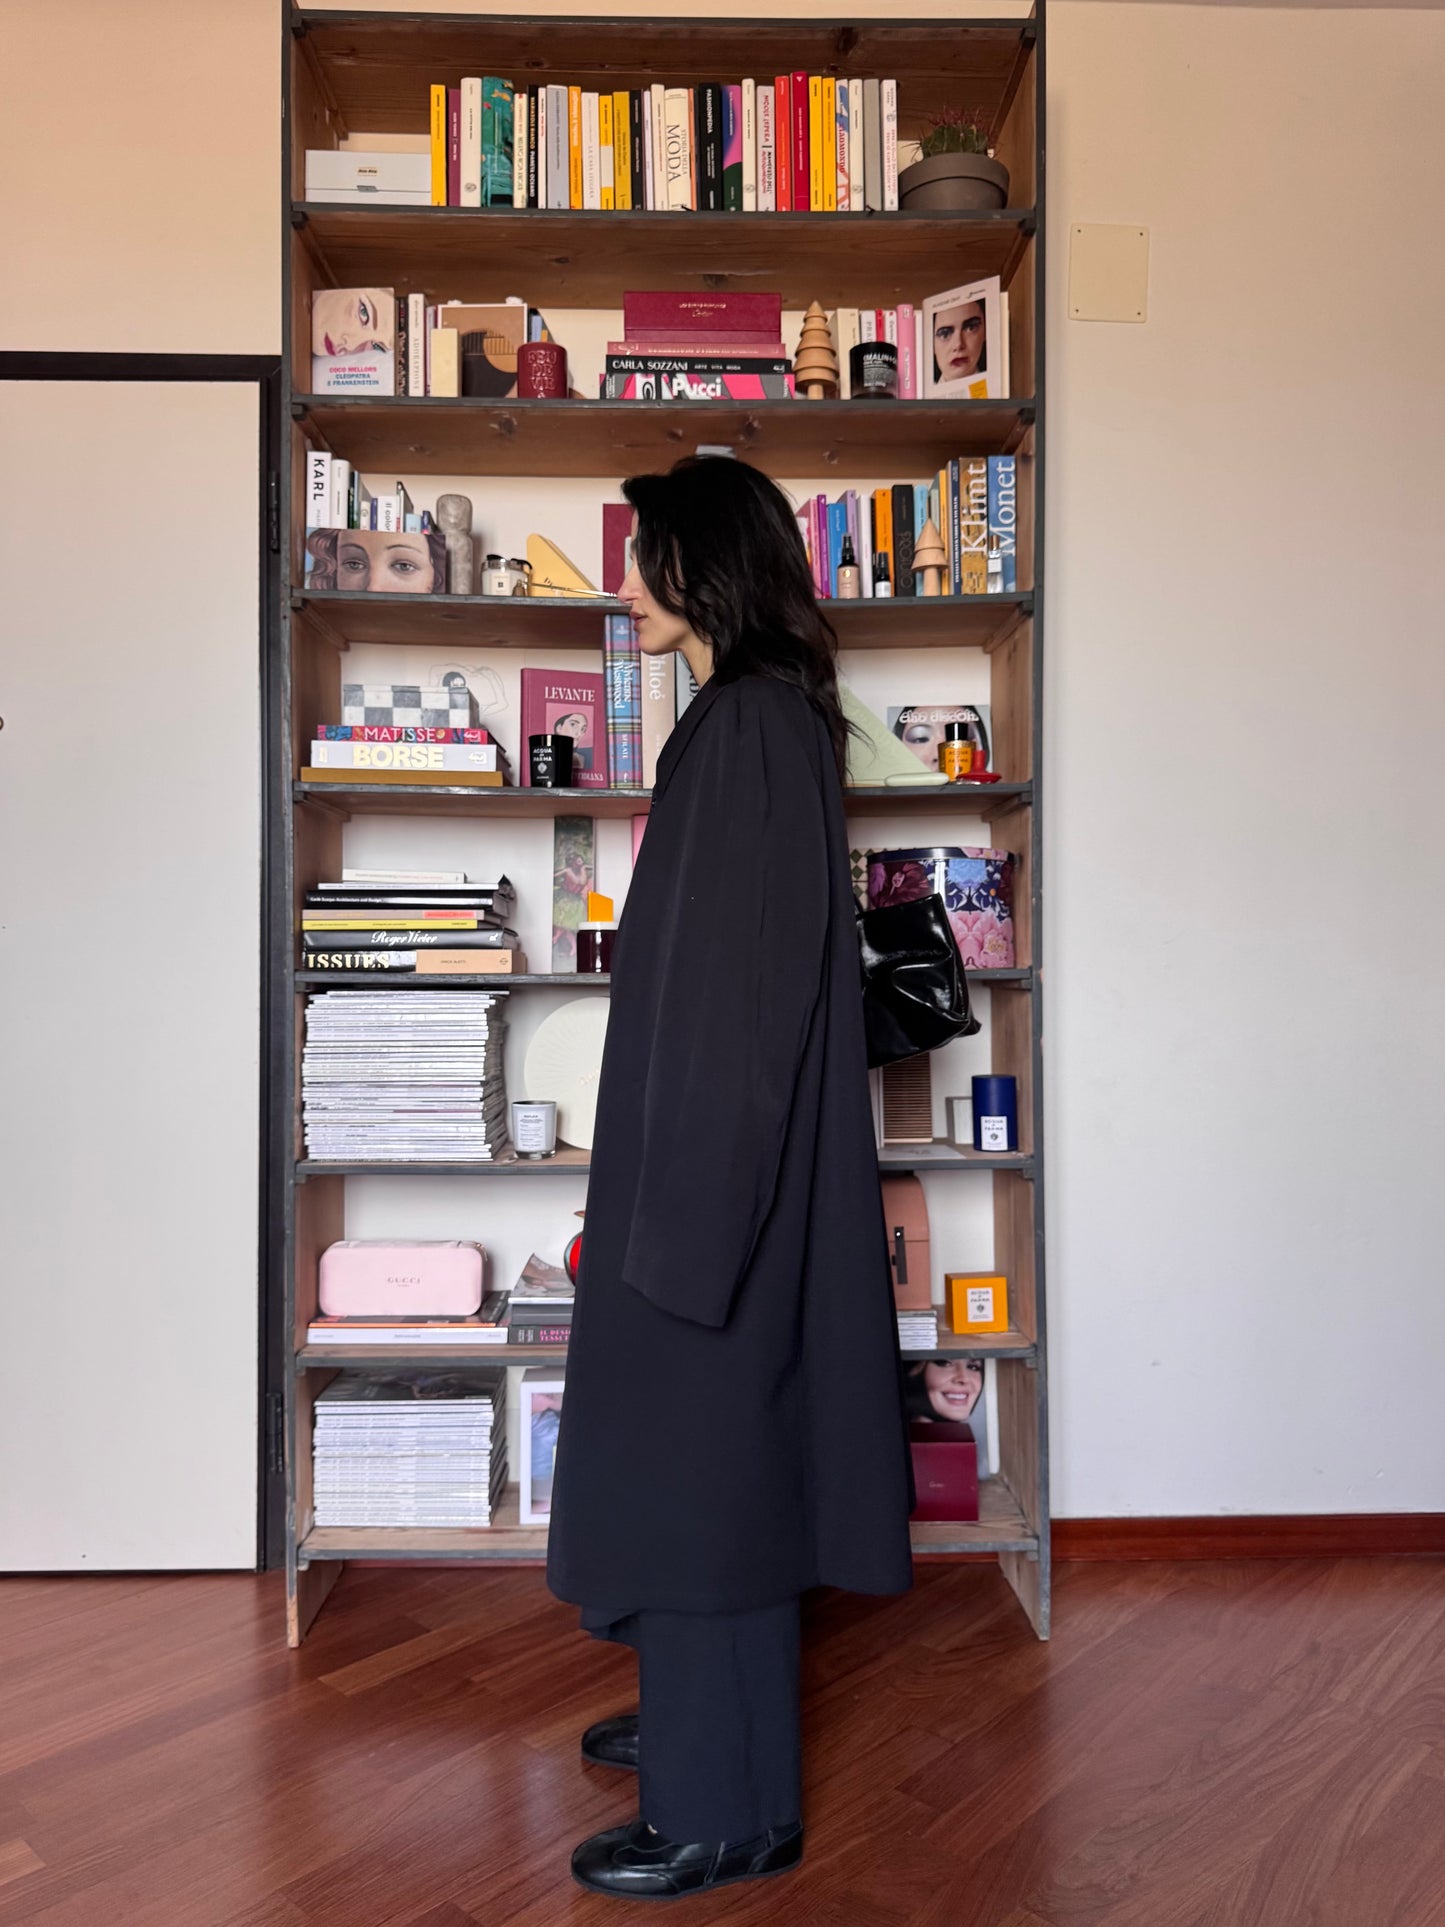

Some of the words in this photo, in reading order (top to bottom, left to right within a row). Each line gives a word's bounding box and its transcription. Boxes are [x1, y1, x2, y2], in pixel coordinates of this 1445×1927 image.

[666, 124, 681, 183] MODA
[612, 360, 644, 370] CARLA
[647, 361, 688, 371] SOZZANI
[672, 376, 722, 398] Pucci
[313, 459, 325, 501] KARL
[960, 463, 987, 555] Klimt
[989, 461, 1016, 557] Monet
[544, 686, 596, 702] LEVANTE
[364, 727, 436, 741] MATISSE
[353, 744, 444, 768] BORSE
[371, 931, 411, 946] Roger
[307, 953, 390, 968] ISSUES
